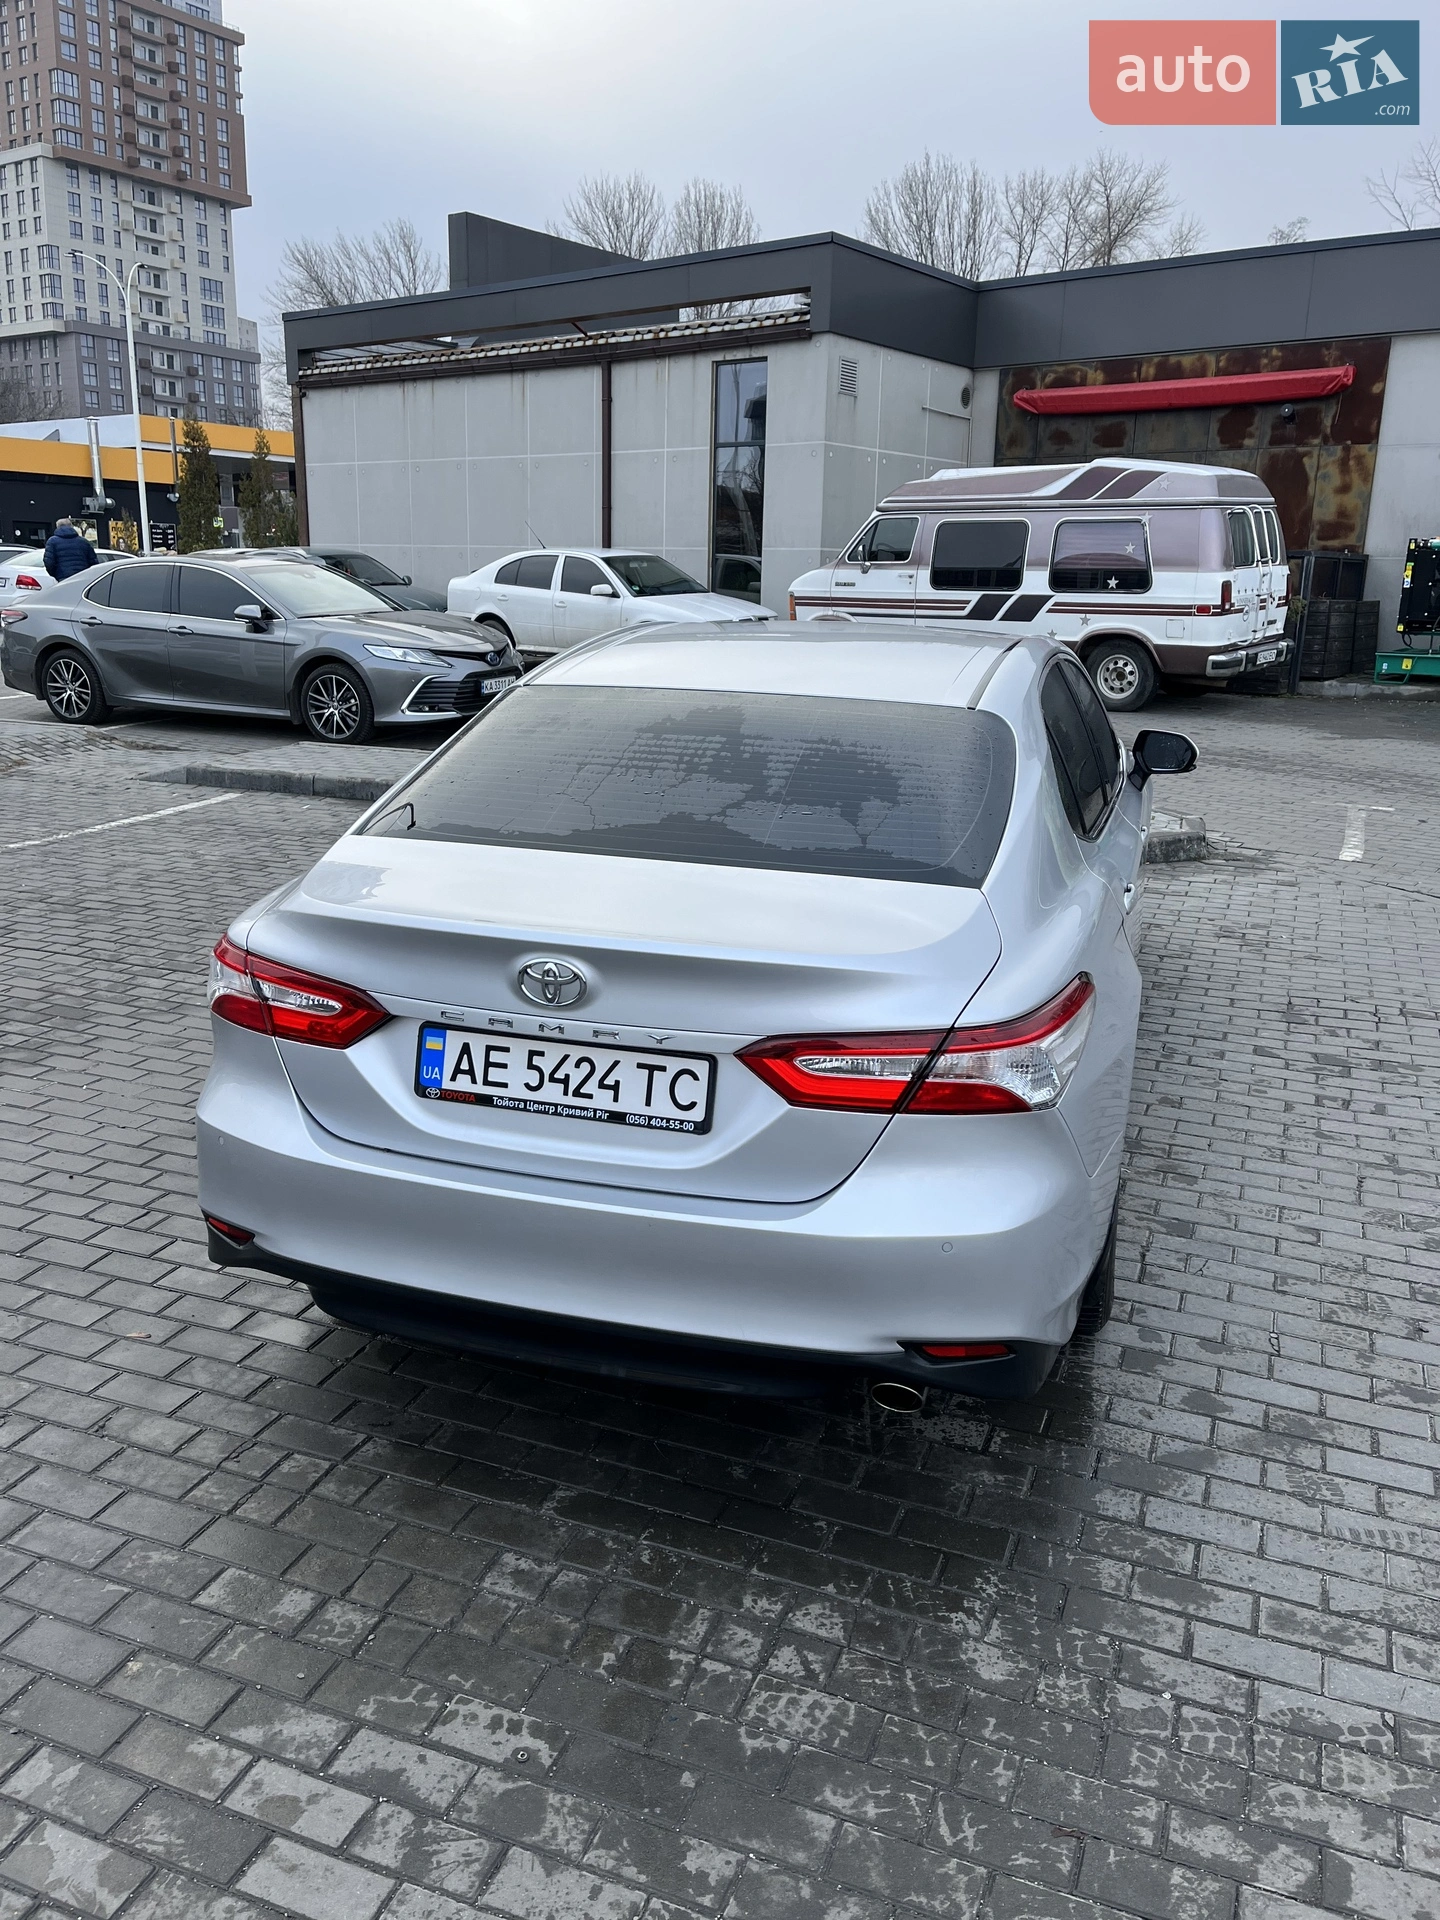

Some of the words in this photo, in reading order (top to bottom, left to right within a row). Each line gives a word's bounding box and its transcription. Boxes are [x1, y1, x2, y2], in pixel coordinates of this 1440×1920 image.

[440, 1010, 677, 1045] CAMRY
[423, 1065, 441, 1080] UA
[449, 1041, 511, 1089] AE
[523, 1048, 621, 1103] 5424
[636, 1062, 701, 1112] TC
[440, 1090, 476, 1102] TOYOTA
[492, 1096, 525, 1109] Тойота
[526, 1101, 556, 1114] Центр
[557, 1106, 594, 1118] Кривий
[595, 1110, 610, 1120] Ріг
[625, 1113, 649, 1126] (056)
[650, 1117, 695, 1131] 404-55-00
